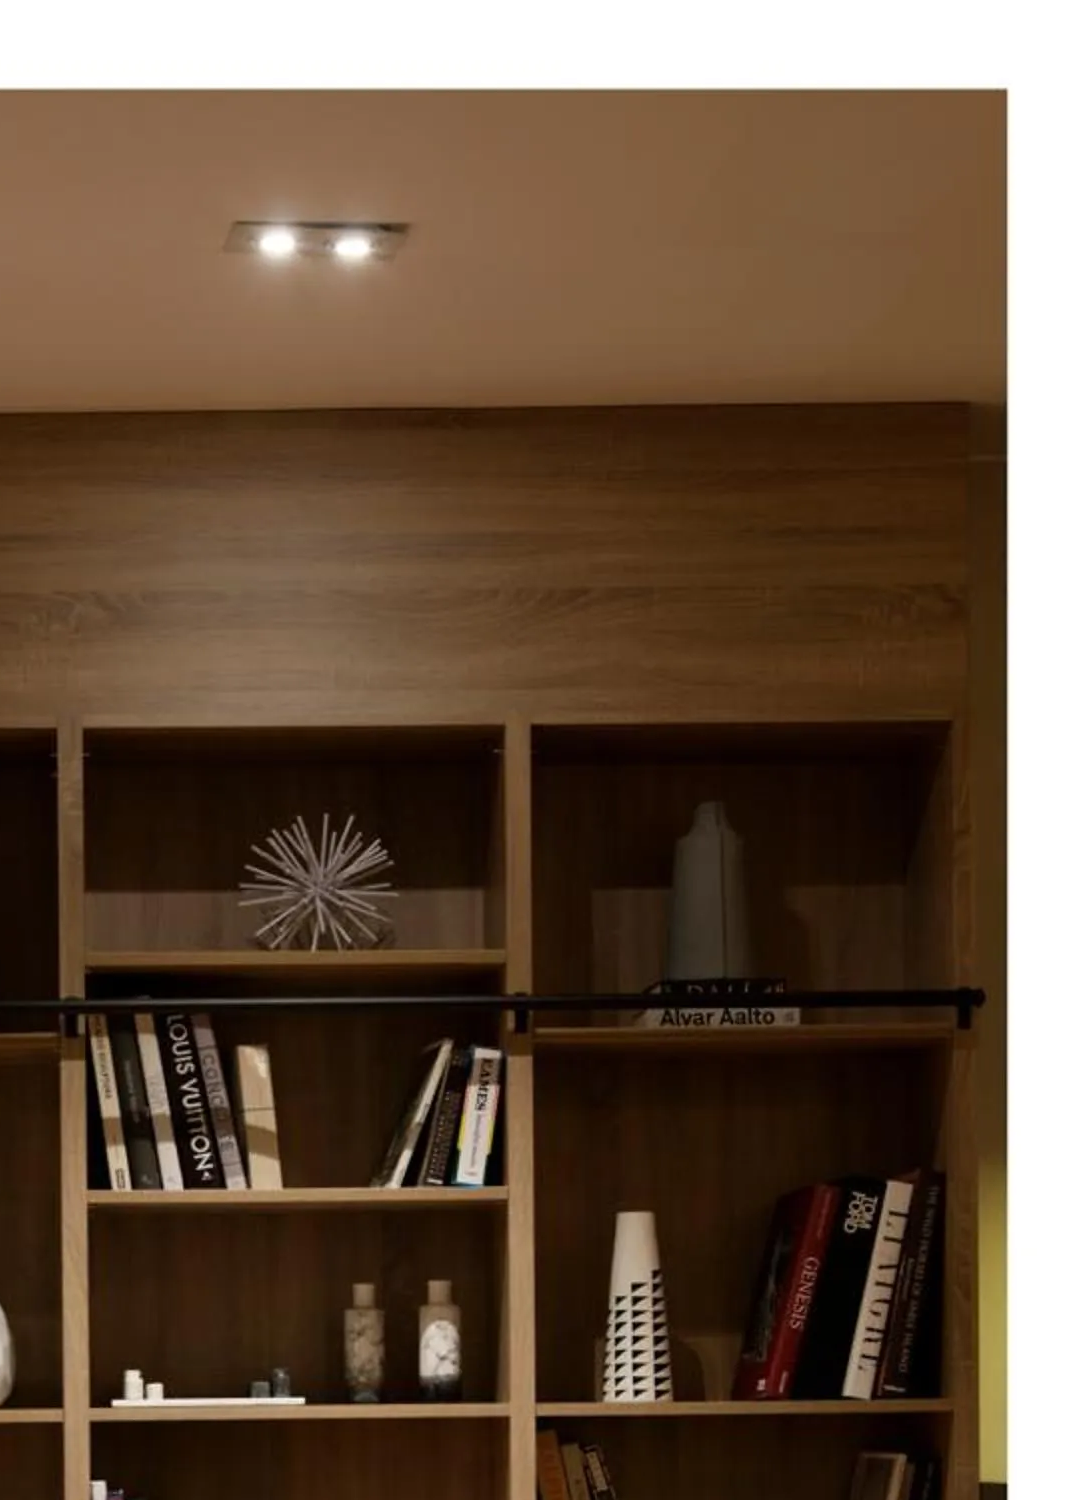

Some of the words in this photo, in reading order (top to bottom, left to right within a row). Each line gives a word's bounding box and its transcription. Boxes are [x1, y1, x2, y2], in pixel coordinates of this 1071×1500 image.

[165, 1014, 196, 1075] LOUIS
[660, 1007, 714, 1026] Alvar
[720, 1007, 775, 1025] Aalto
[202, 1055, 235, 1149] CONCE
[475, 1059, 494, 1111] EAMES
[179, 1078, 216, 1171] VUITTON
[844, 1191, 866, 1235] FORD
[862, 1195, 879, 1230] TOM
[790, 1256, 821, 1330] GENESIS
